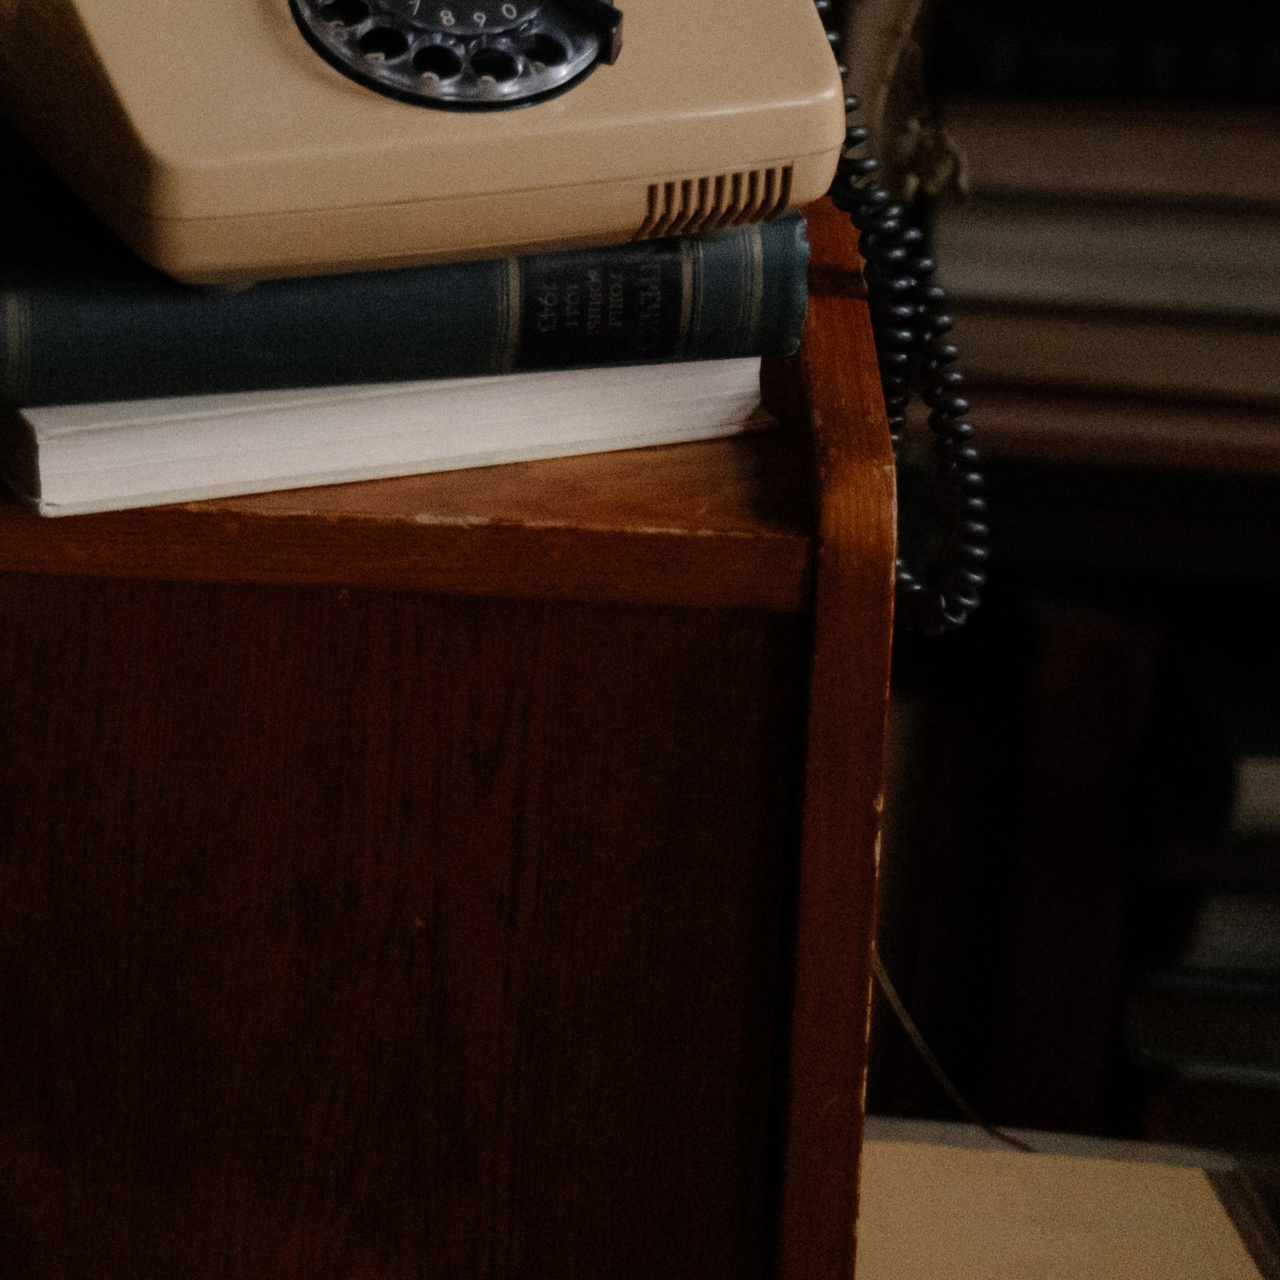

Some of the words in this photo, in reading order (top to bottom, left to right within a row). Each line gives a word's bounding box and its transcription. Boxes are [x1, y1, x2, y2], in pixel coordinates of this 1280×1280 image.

[408, 0, 421, 15] 7
[501, 3, 517, 20] 0
[439, 9, 455, 27] 8
[472, 11, 486, 28] 9
